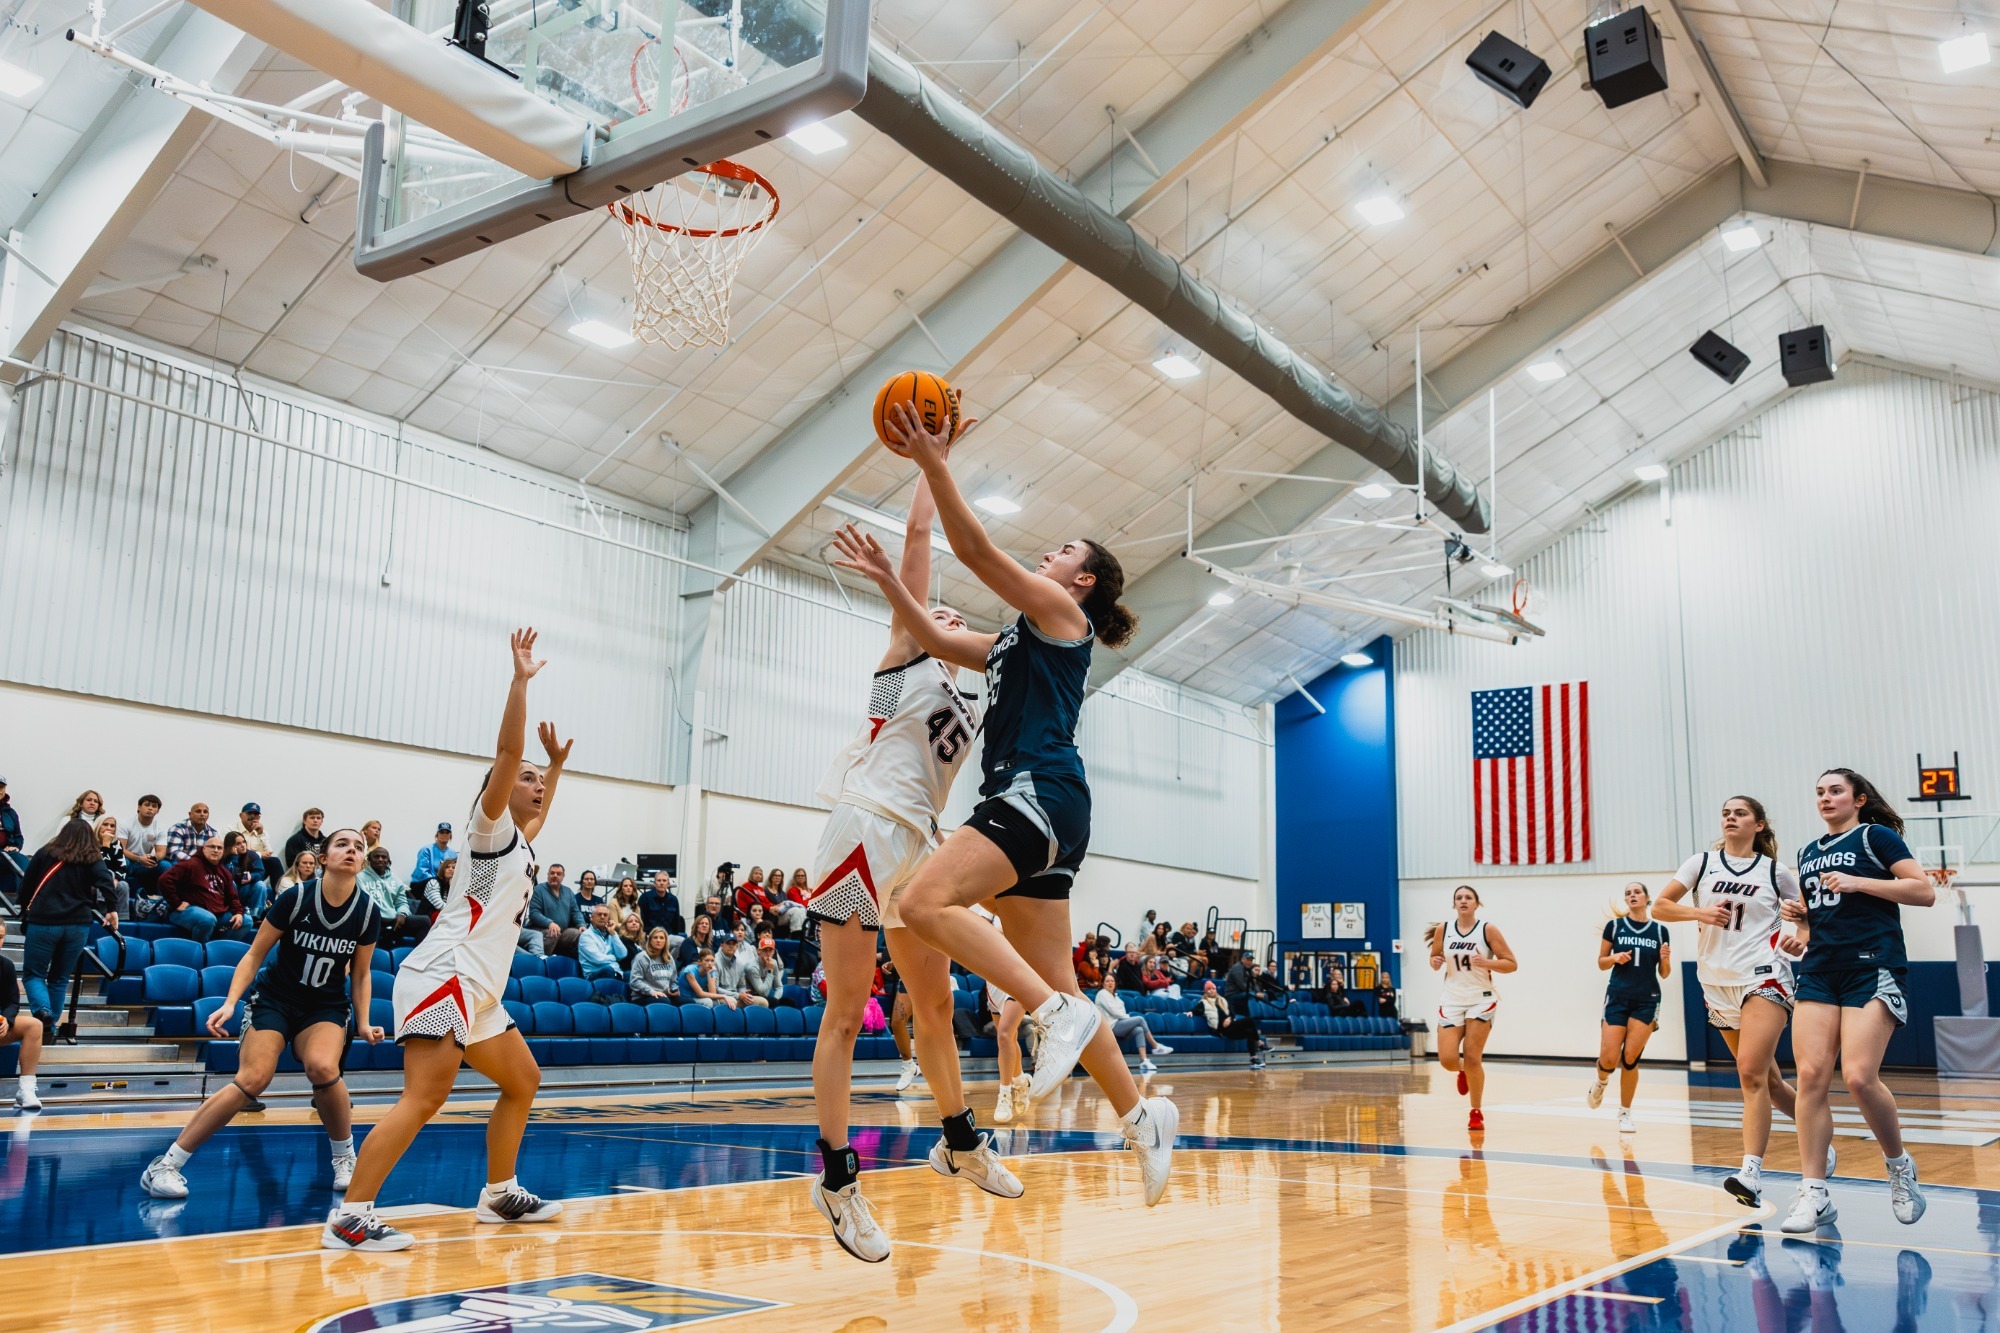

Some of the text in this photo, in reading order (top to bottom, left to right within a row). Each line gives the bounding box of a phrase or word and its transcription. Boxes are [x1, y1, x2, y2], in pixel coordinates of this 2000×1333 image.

[925, 706, 970, 764] 45
[1922, 770, 1955, 794] 27
[1712, 881, 1761, 897] OWU
[293, 929, 358, 955] VIKINGS
[1448, 942, 1477, 951] OWU
[1617, 936, 1657, 949] VIKINGS
[1453, 953, 1472, 971] 14
[1633, 947, 1641, 967] 1
[299, 953, 336, 988] 10
